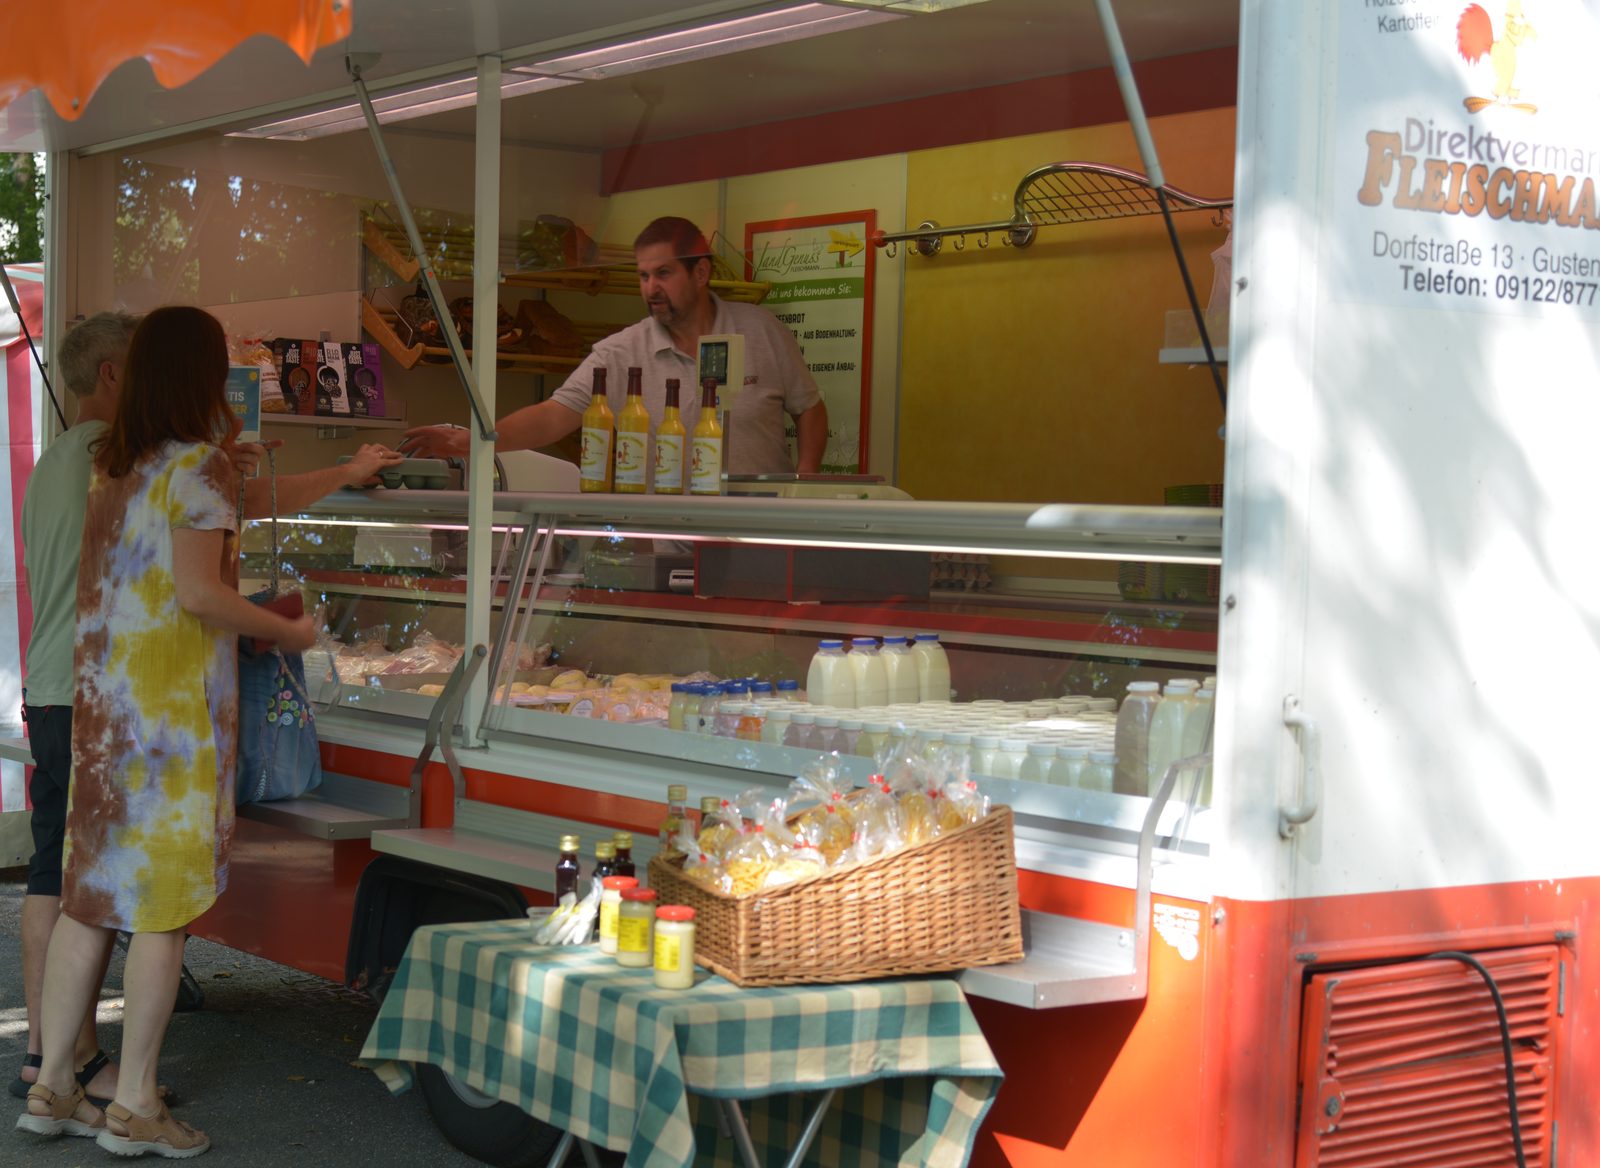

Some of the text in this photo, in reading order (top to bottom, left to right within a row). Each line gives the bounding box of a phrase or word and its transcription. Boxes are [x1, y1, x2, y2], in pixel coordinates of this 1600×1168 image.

[1405, 117, 1600, 175] Direktvermar
[1373, 230, 1482, 266] Dorfstraße
[1491, 242, 1514, 270] 13
[780, 288, 793, 298] uns
[794, 284, 836, 297] bekommen
[1399, 264, 1488, 297] Telefon:
[803, 331, 814, 339] AUS
[812, 362, 835, 373] EIGENEN
